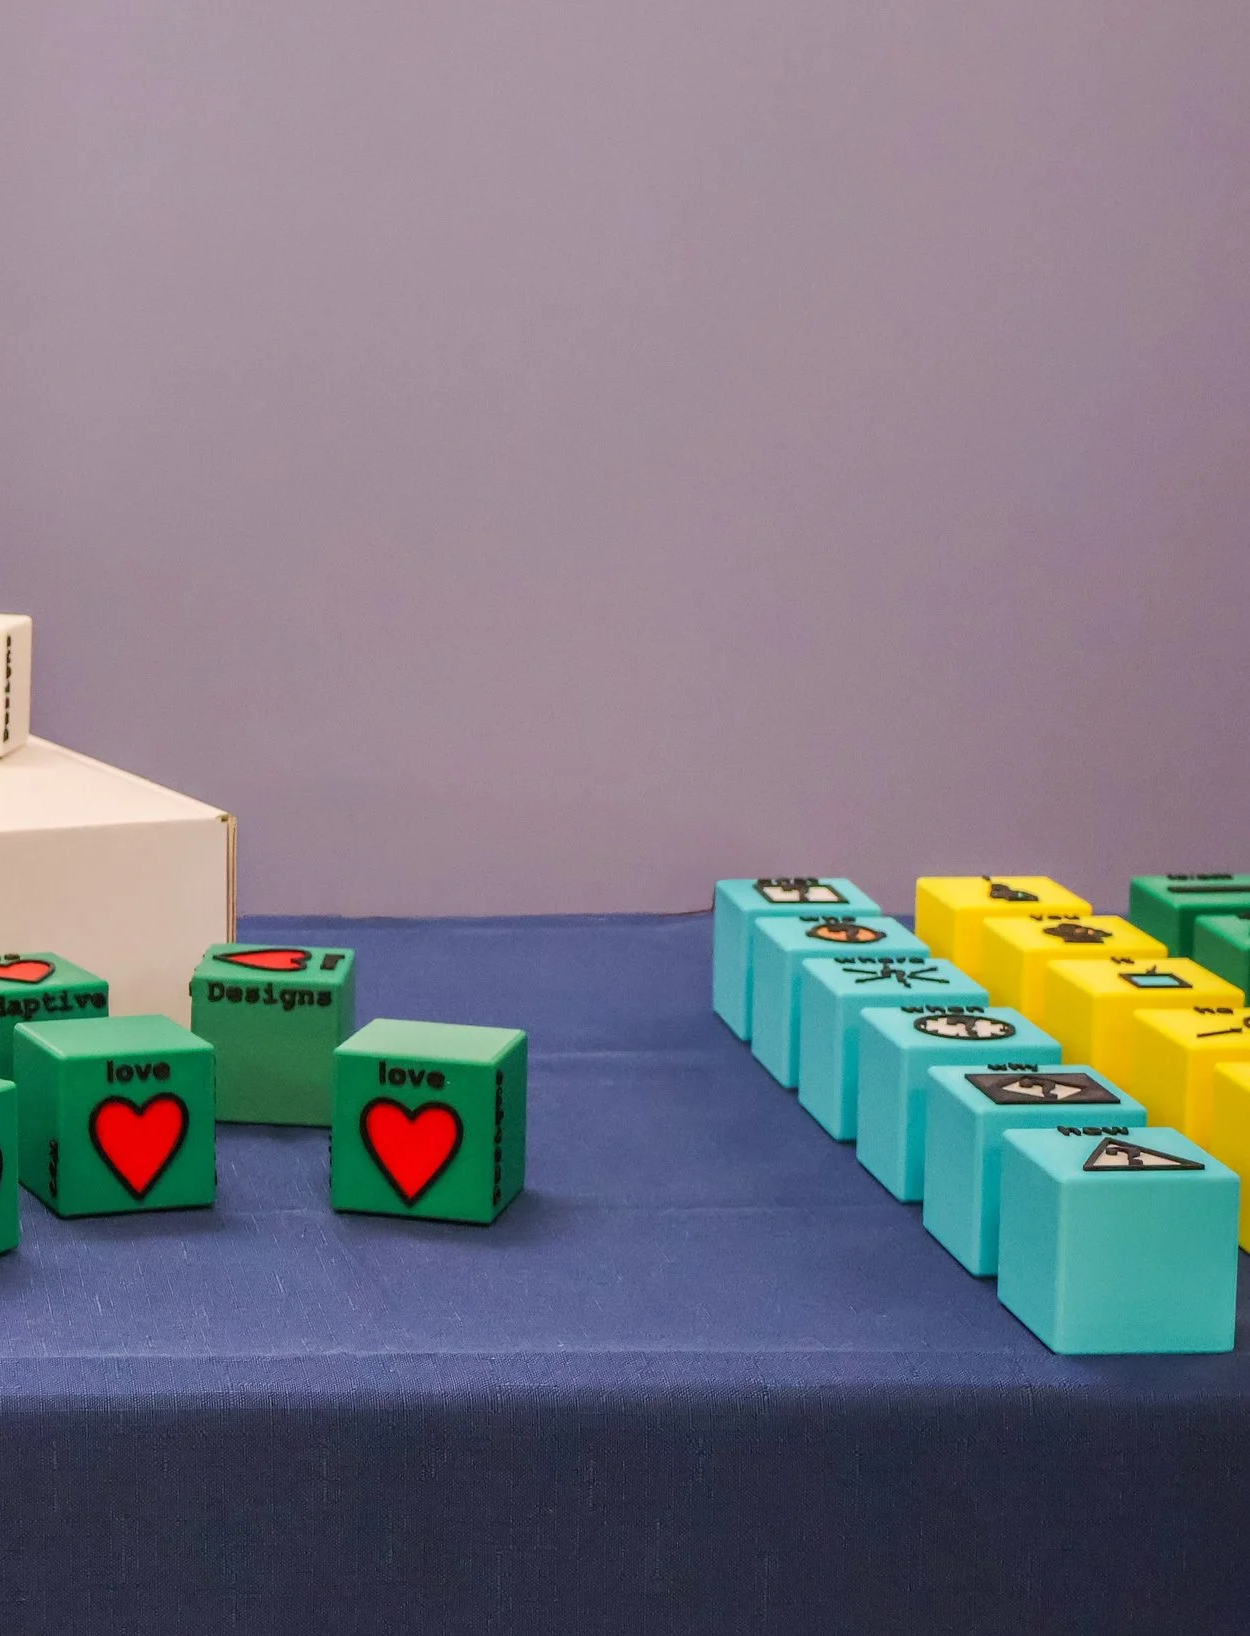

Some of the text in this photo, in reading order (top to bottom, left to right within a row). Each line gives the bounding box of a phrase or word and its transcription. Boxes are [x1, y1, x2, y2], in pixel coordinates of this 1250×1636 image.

[207, 981, 333, 1012] Designs
[106, 1059, 171, 1083] love
[378, 1060, 446, 1090] love
